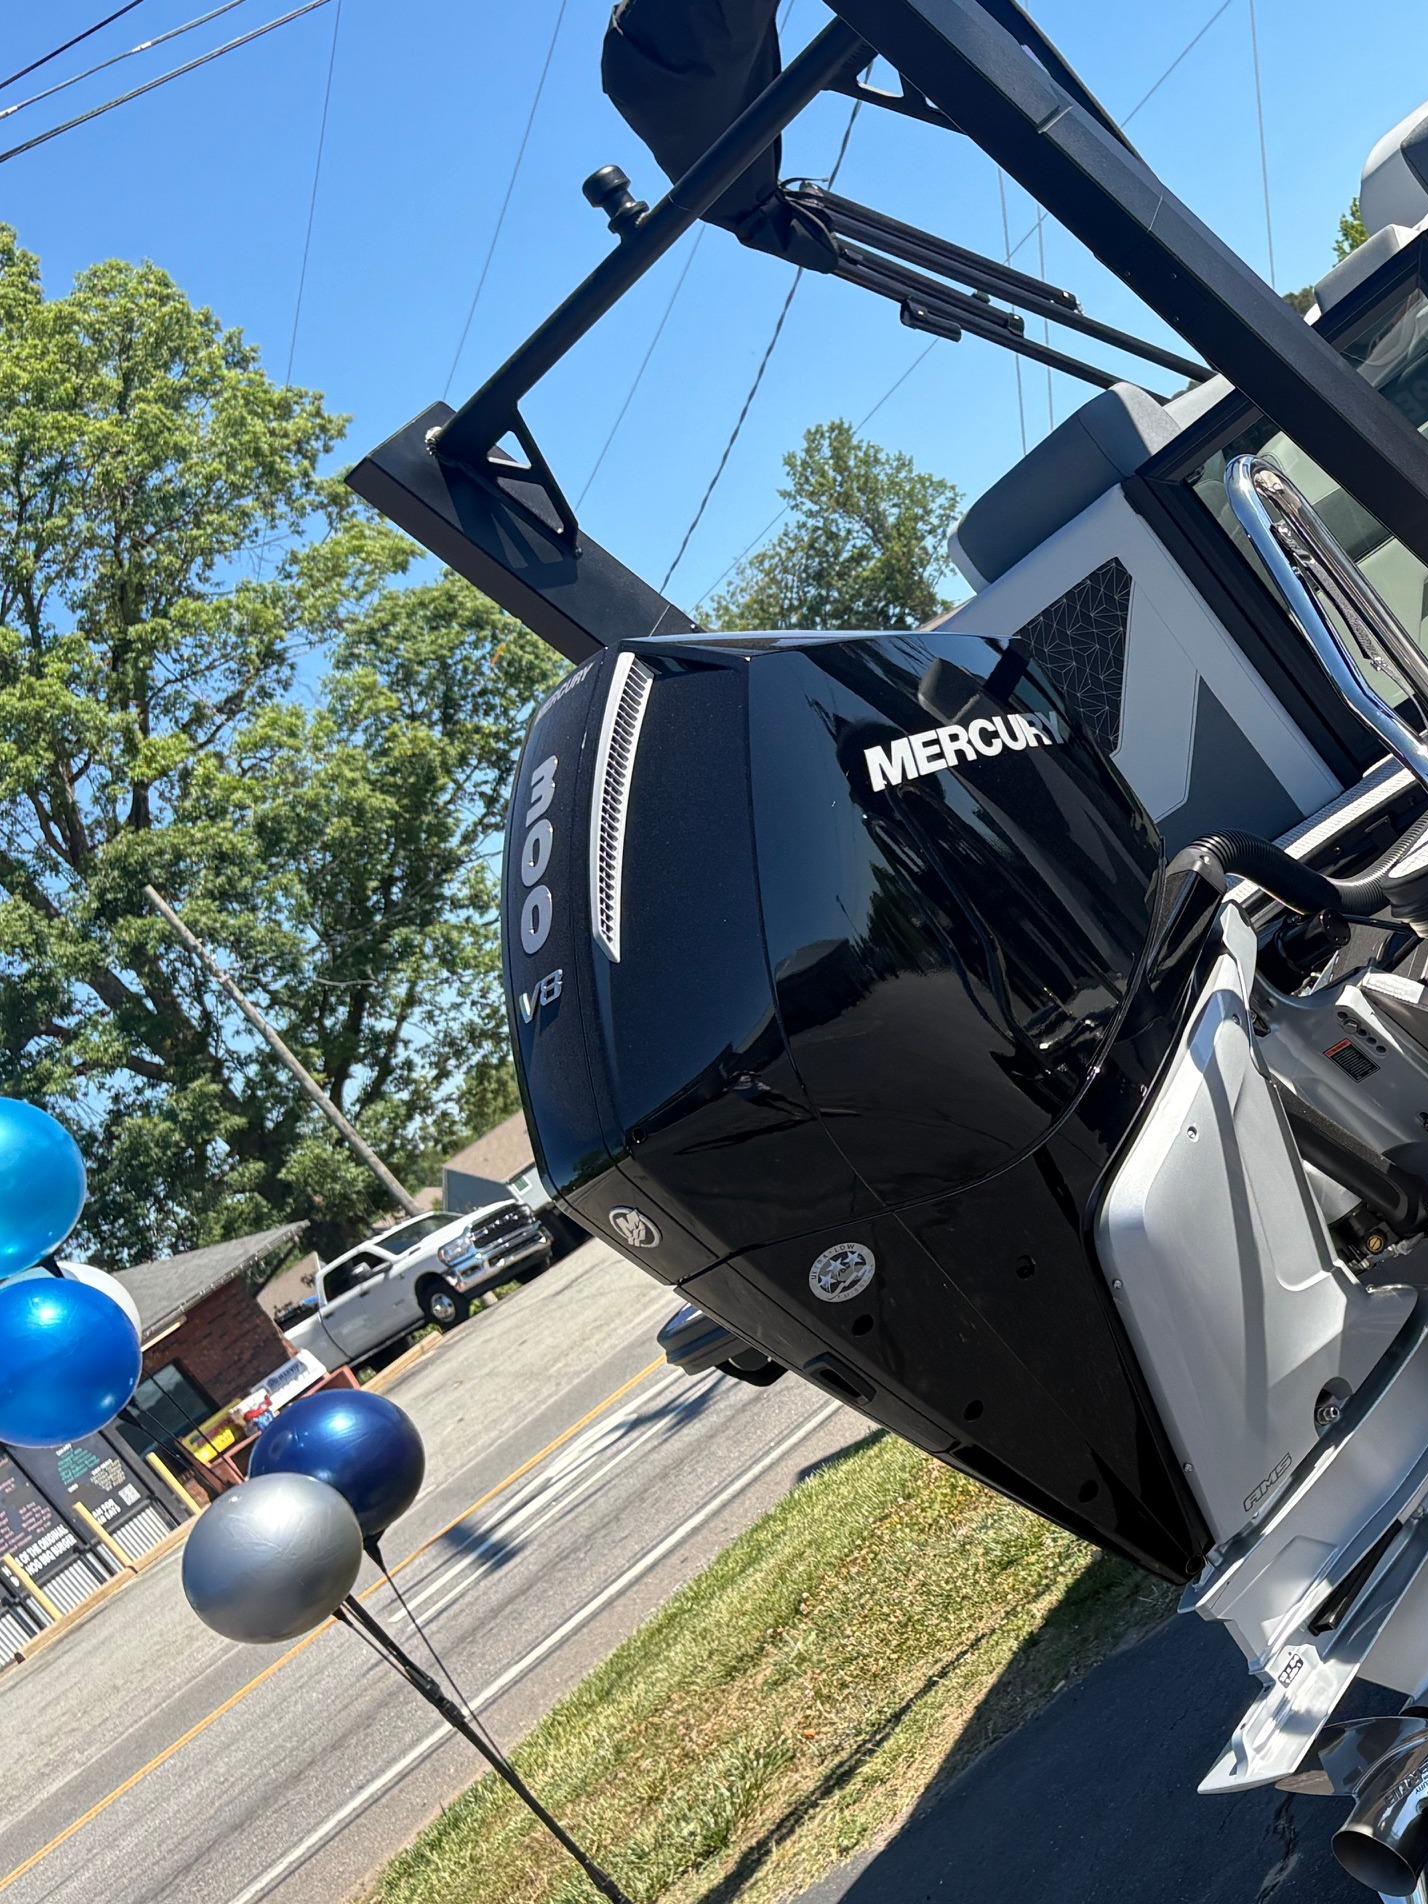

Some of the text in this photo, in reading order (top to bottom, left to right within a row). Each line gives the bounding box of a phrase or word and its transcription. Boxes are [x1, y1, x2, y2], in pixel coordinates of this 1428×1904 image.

[863, 711, 1064, 792] MERCURY
[520, 755, 558, 955] 300
[519, 968, 563, 1023] V8
[1244, 1452, 1292, 1512] AMS
